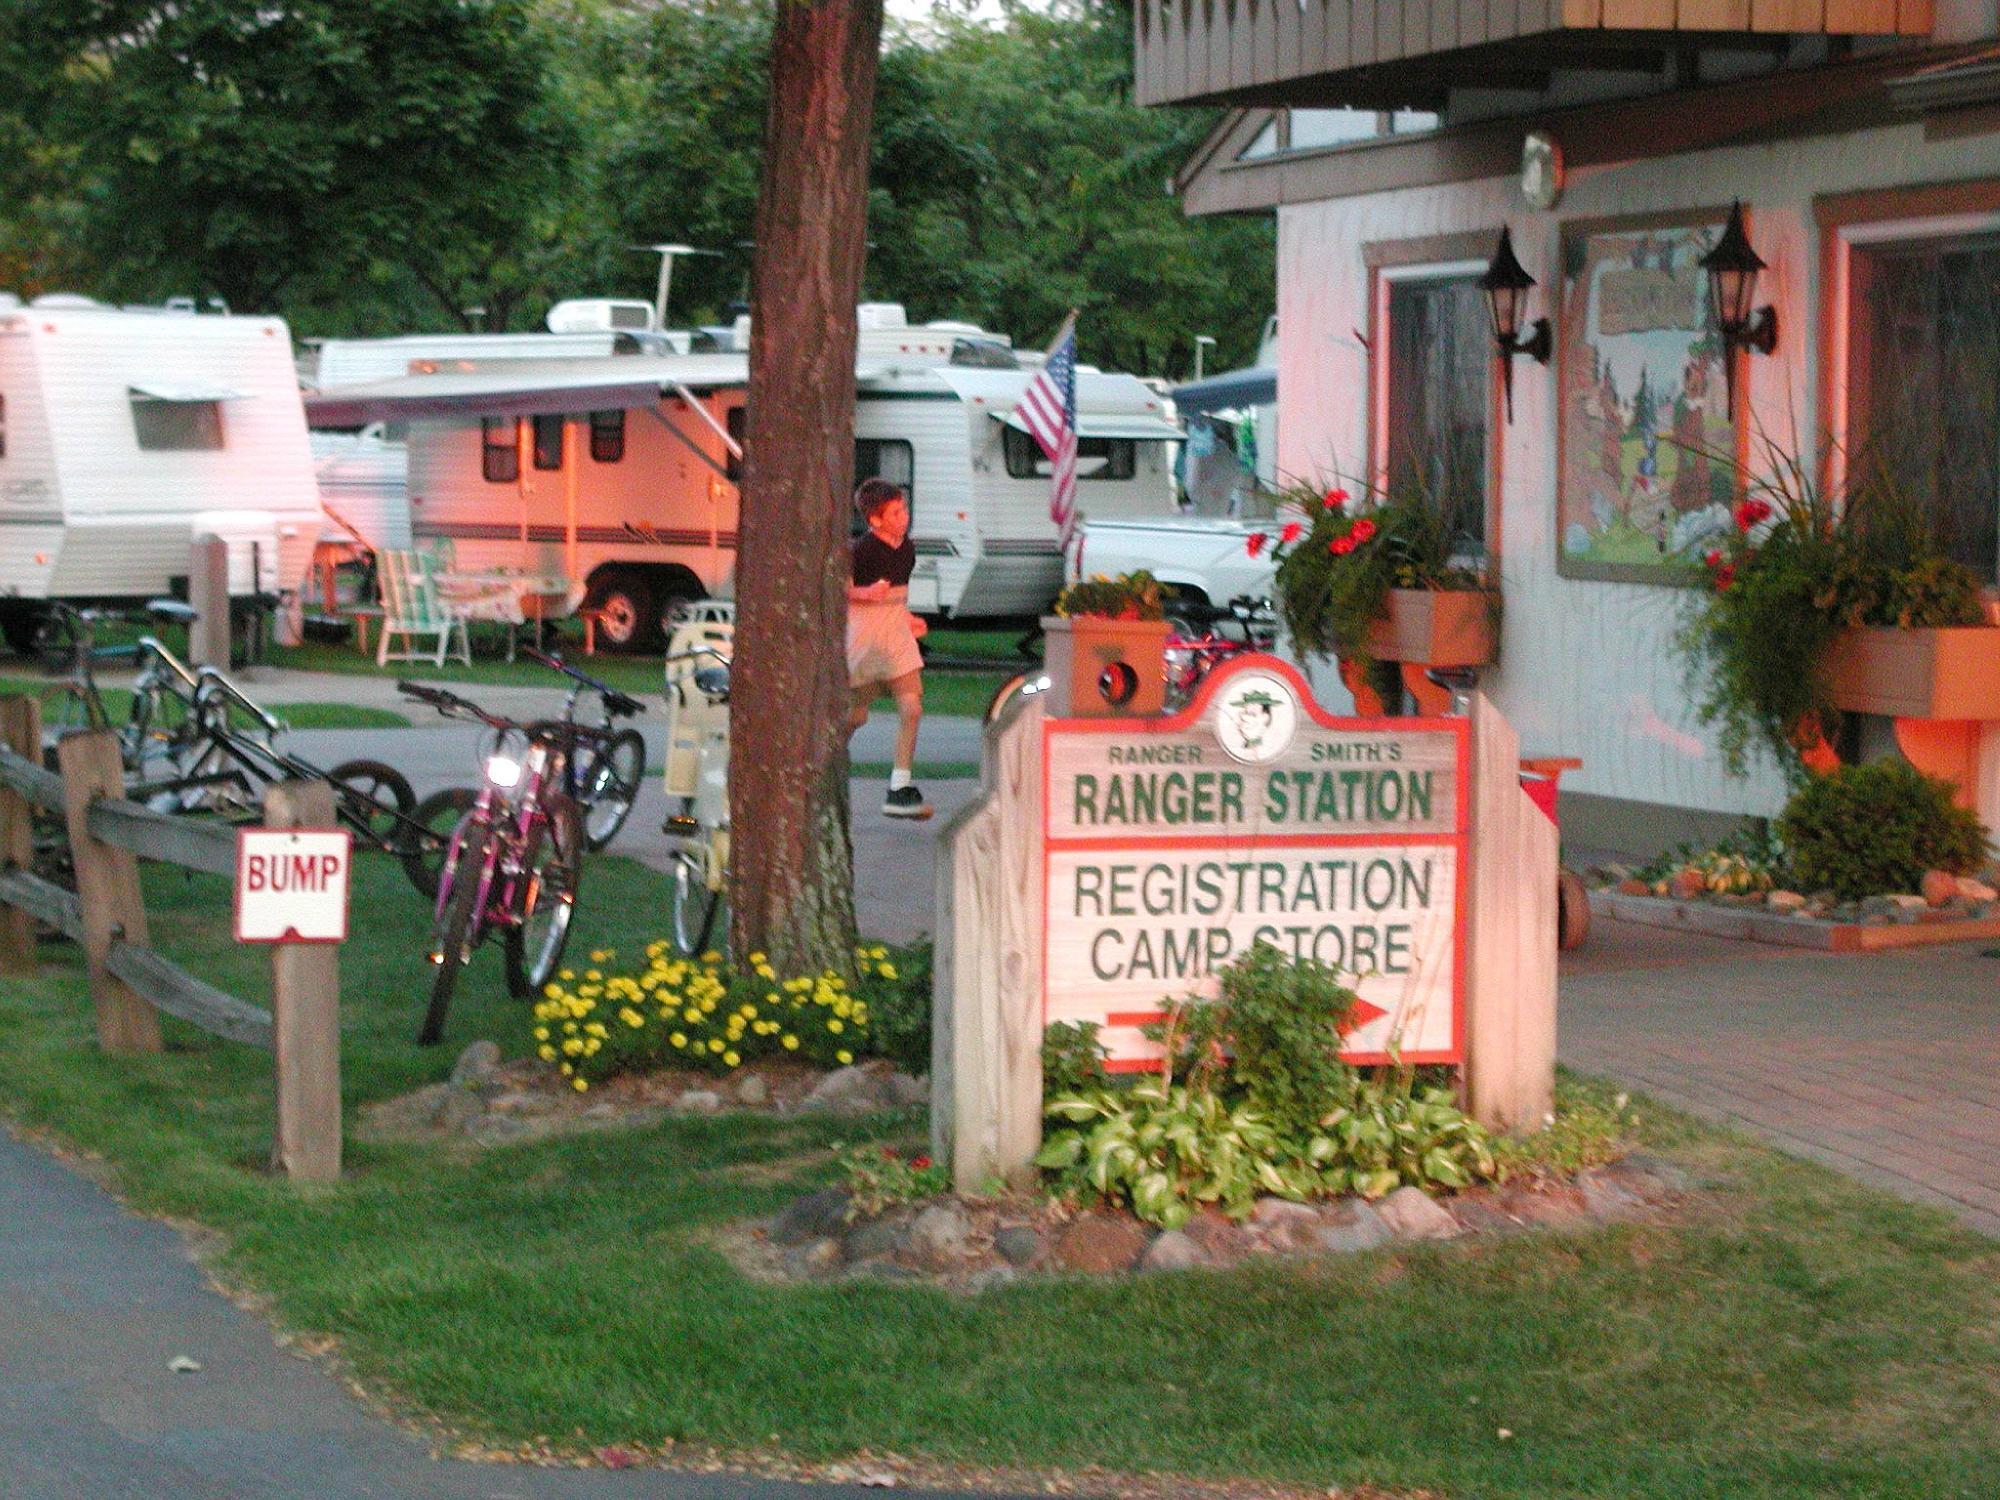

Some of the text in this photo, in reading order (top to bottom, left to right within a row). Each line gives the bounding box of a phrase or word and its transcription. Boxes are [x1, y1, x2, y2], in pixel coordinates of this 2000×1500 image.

[1108, 741, 1402, 765] RANGER SMITH'S
[1074, 769, 1434, 825] RANGER STATION
[248, 855, 339, 892] BUMP
[1074, 858, 1432, 917] REGISTRATION
[1091, 927, 1233, 981] CAMP
